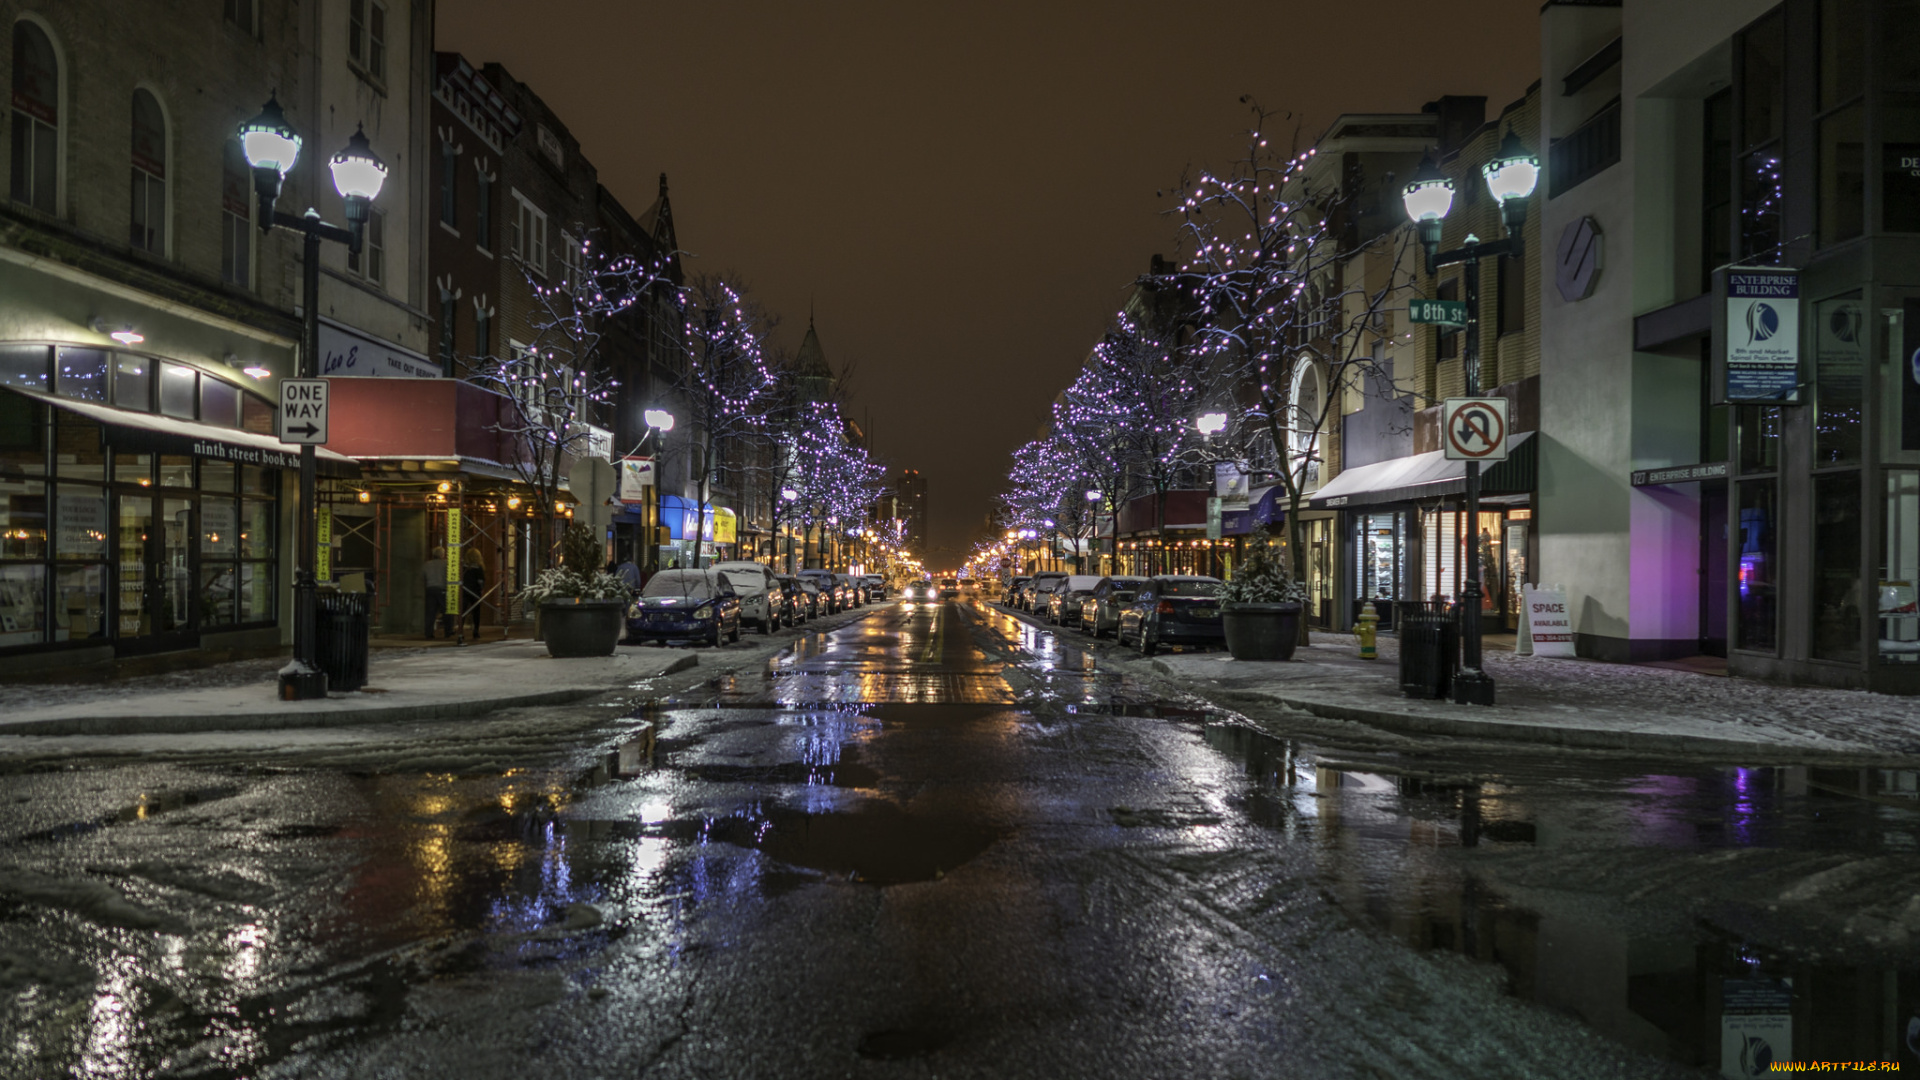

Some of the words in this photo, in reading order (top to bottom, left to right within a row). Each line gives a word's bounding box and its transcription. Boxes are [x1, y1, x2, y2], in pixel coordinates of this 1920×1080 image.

[1730, 275, 1797, 286] ENTERPRISE
[1736, 285, 1791, 296] BUILDING
[1410, 306, 1419, 319] W
[1423, 303, 1446, 321] 8th
[1451, 308, 1463, 321] St
[387, 357, 402, 370] TAKE
[403, 363, 415, 374] OUT
[1730, 354, 1752, 362] Spinal
[286, 385, 323, 401] ONE
[285, 403, 323, 418] WAY
[194, 440, 226, 457] ninth
[228, 447, 259, 462] street
[262, 449, 286, 466] book
[1632, 472, 1646, 485] 727
[1649, 469, 1690, 481] ENTERPRISE
[1692, 465, 1726, 477] BUILDING
[1532, 603, 1565, 613] SPACE
[120, 616, 141, 632] shop
